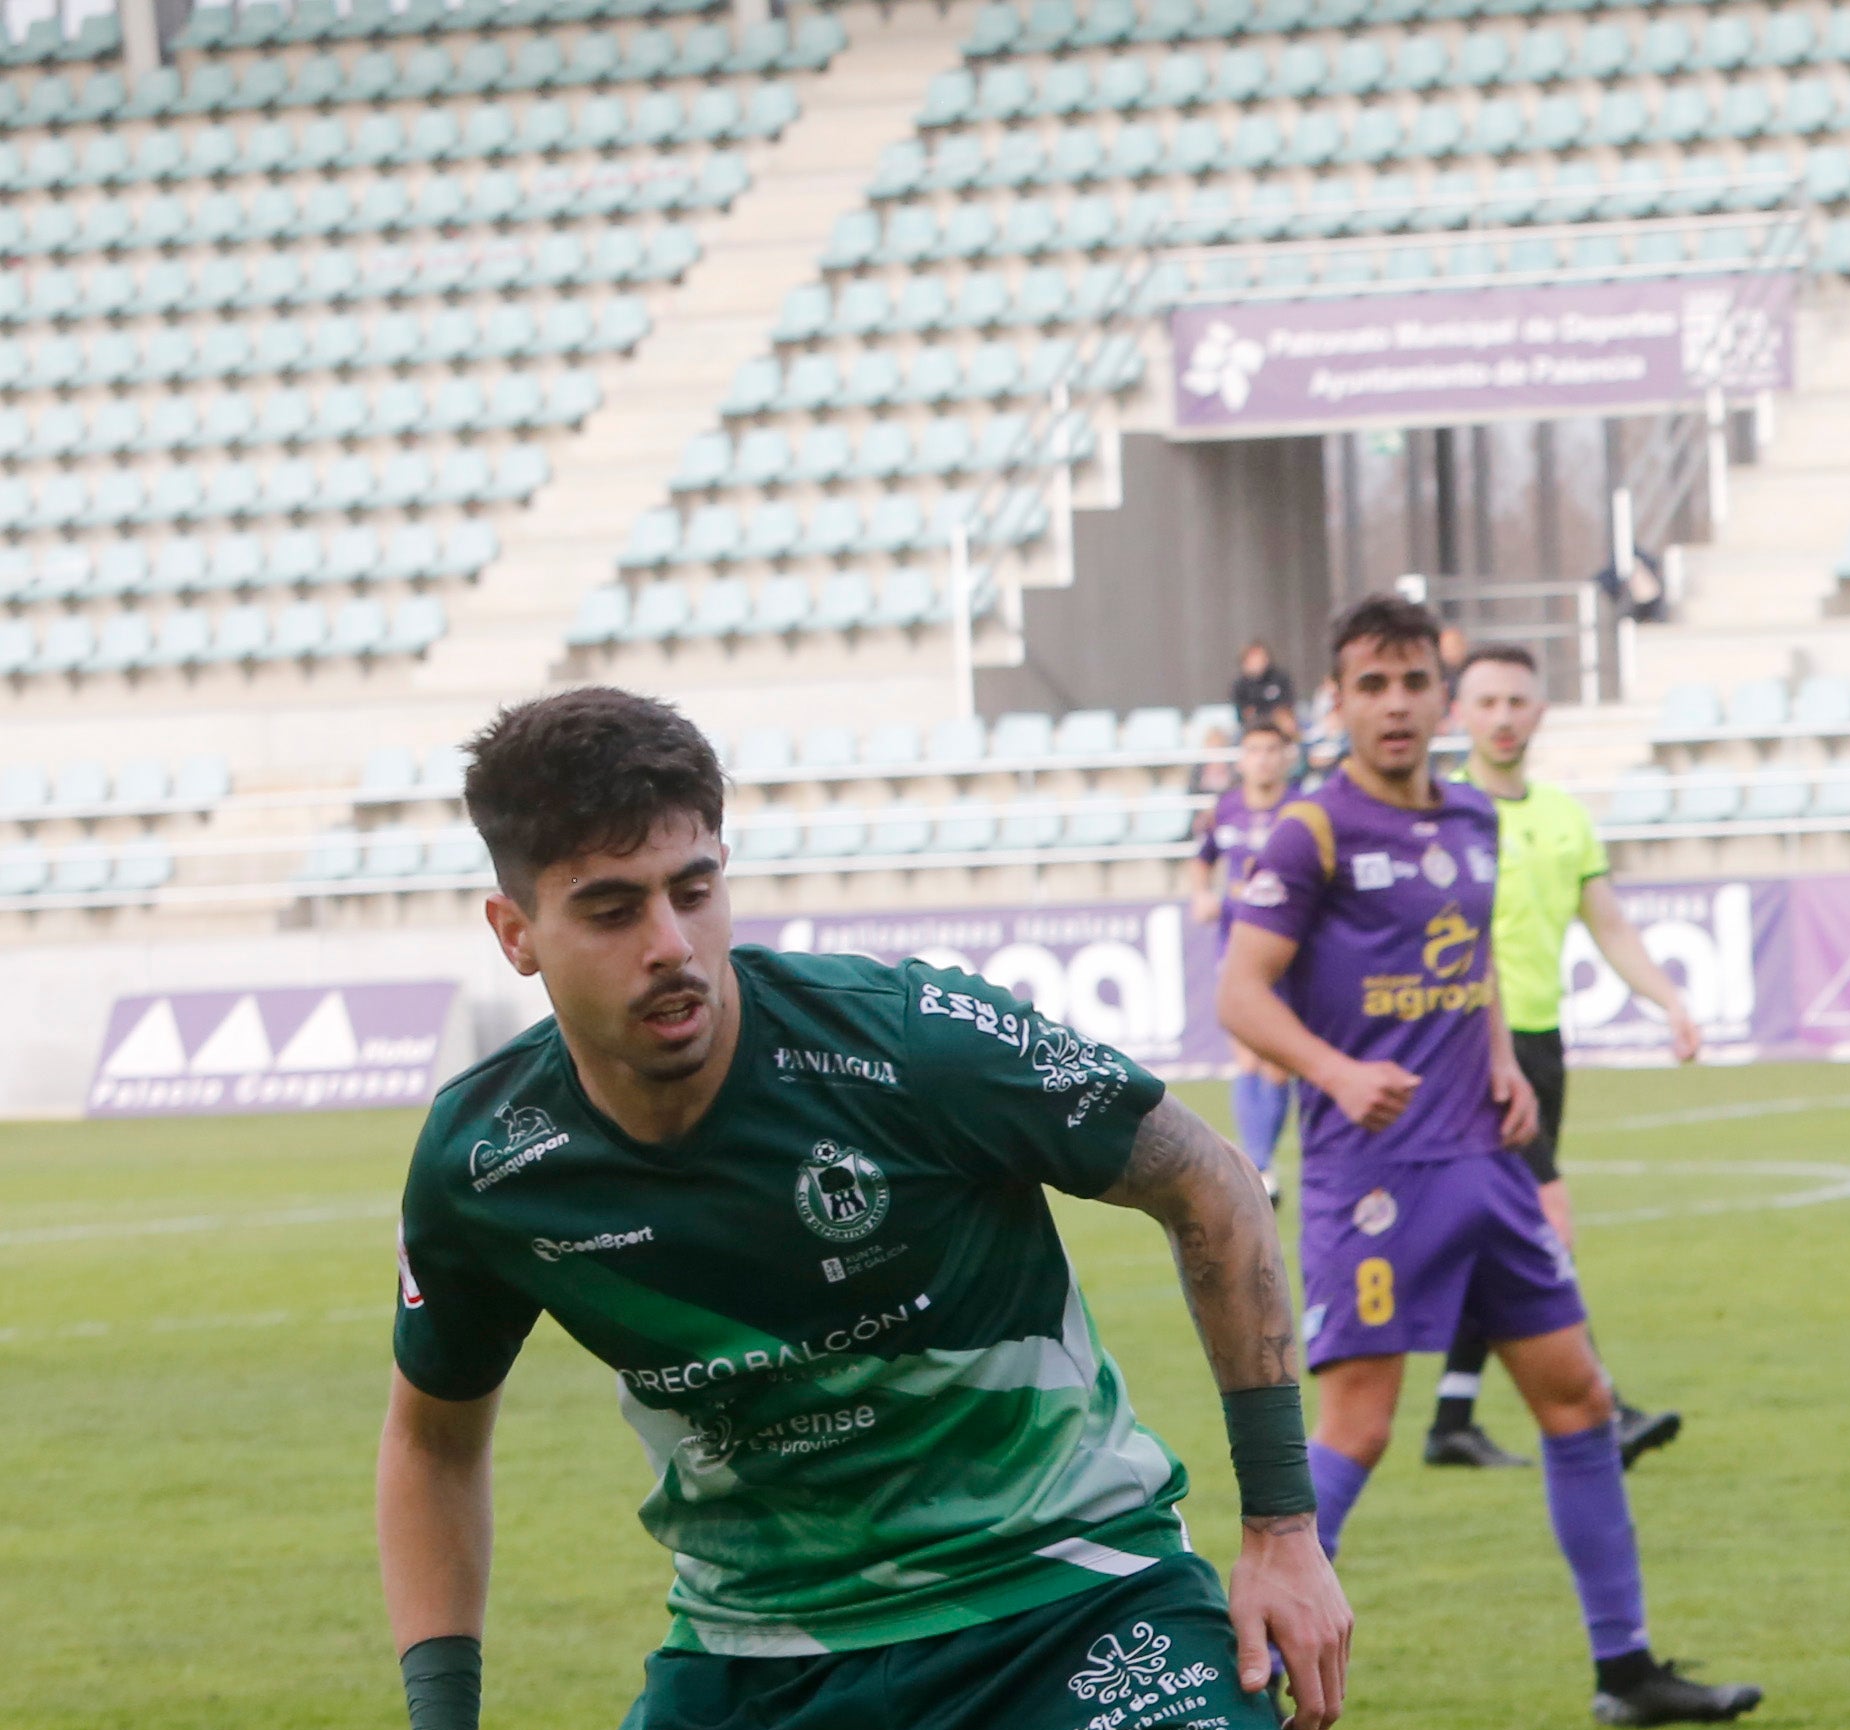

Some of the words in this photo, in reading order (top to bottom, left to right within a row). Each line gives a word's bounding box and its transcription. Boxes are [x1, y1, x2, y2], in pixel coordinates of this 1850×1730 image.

[774, 1046, 897, 1085] PANIAGUA
[233, 1070, 426, 1106] Congresos
[1356, 1256, 1395, 1327] 8
